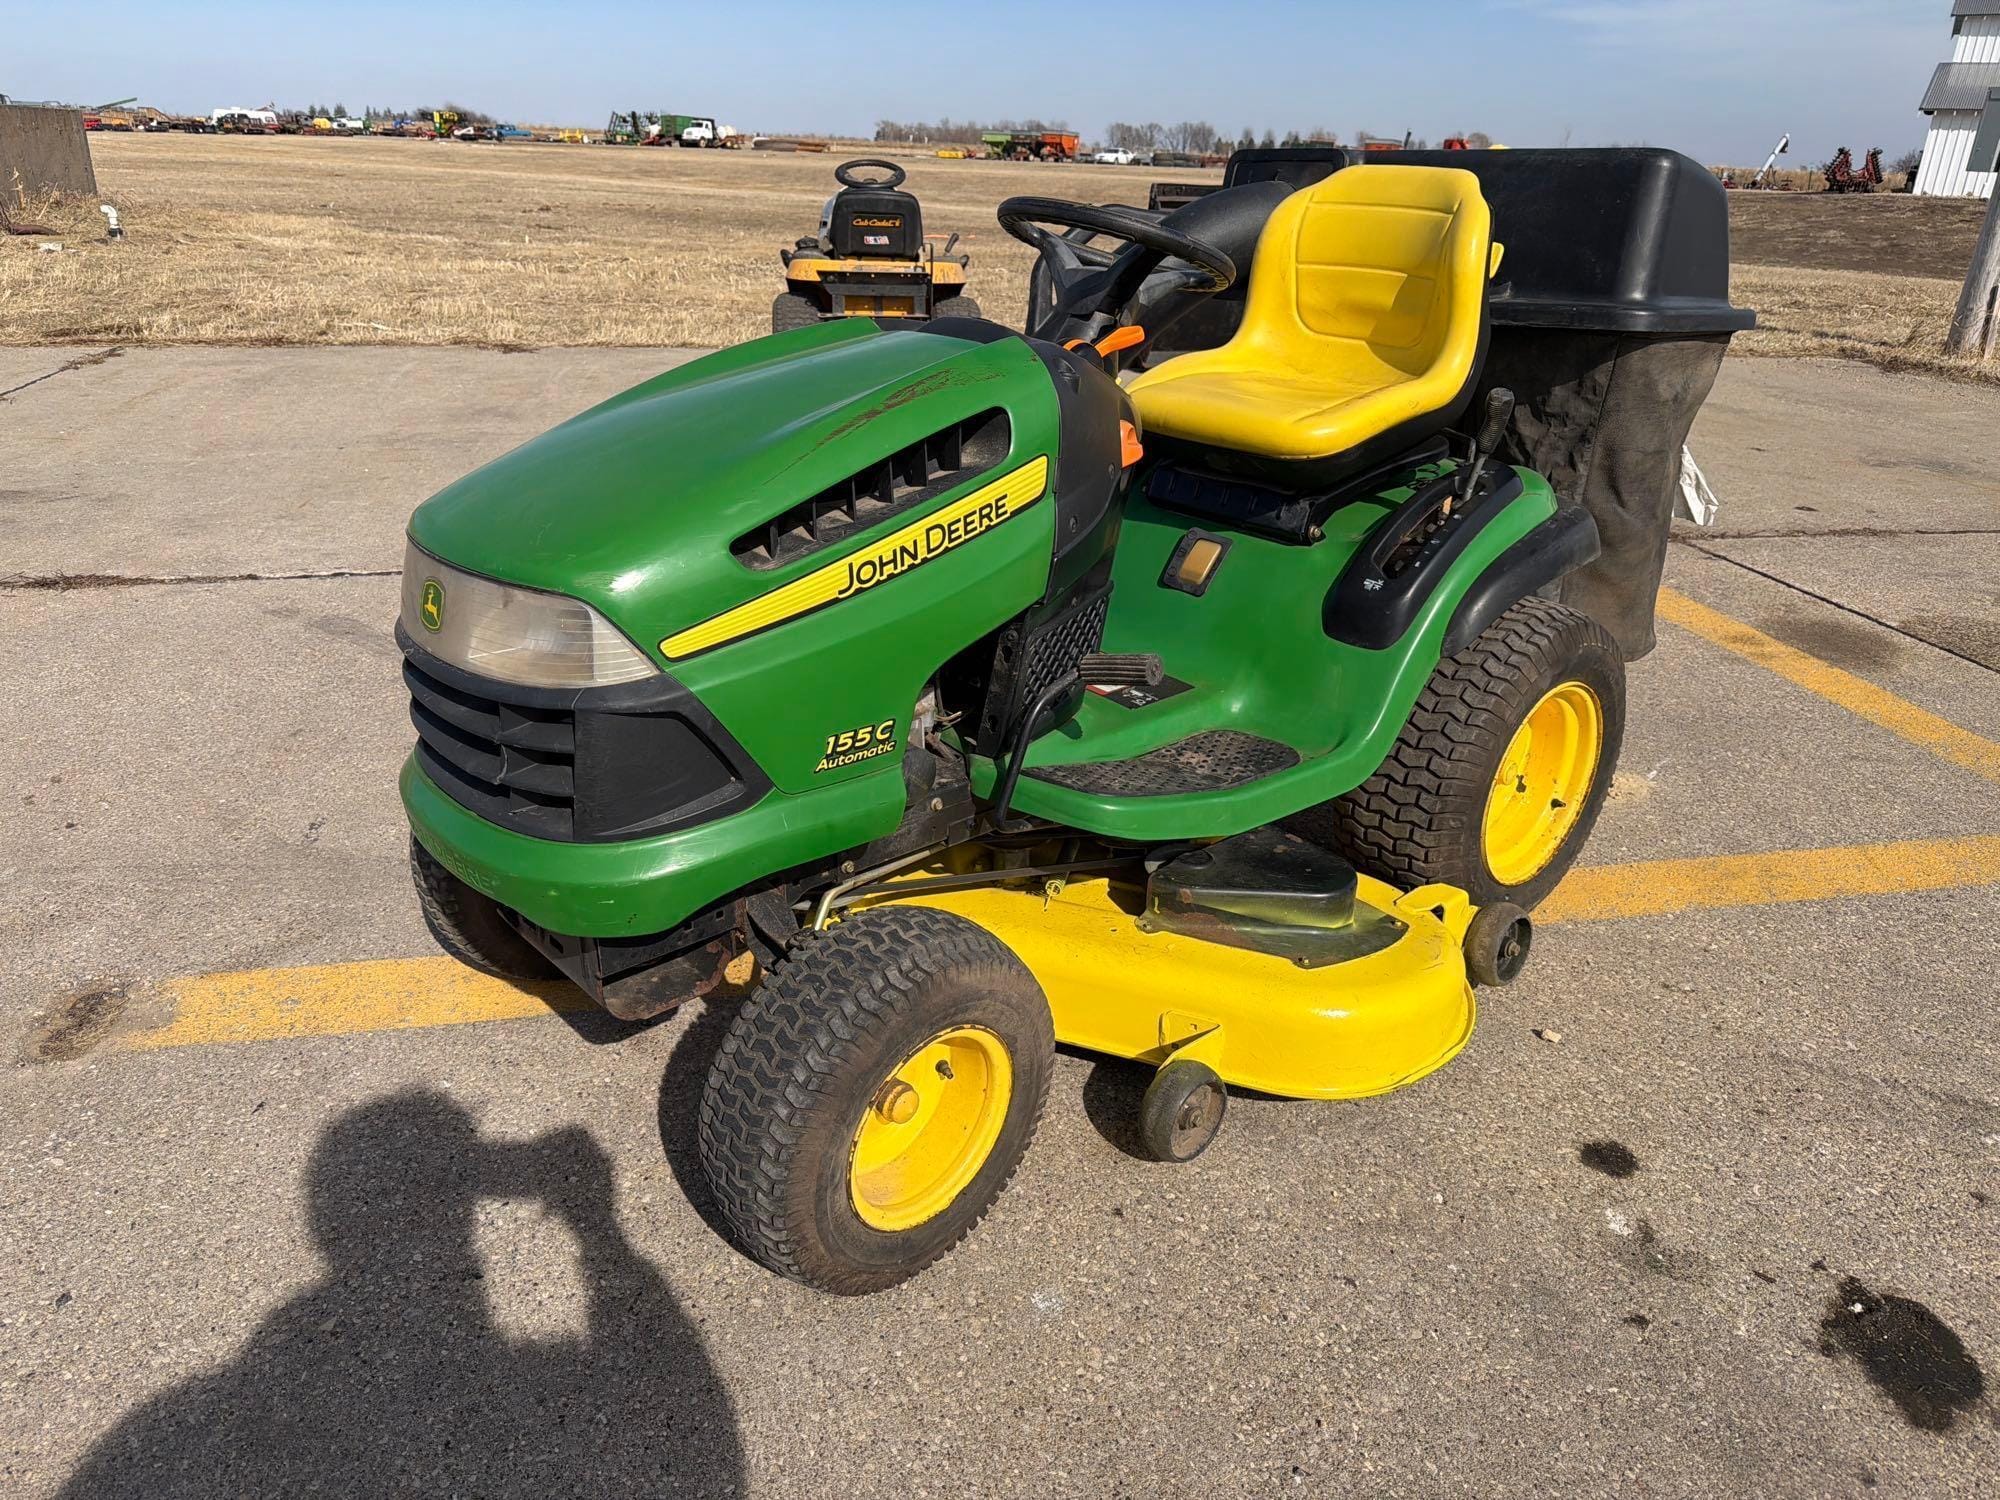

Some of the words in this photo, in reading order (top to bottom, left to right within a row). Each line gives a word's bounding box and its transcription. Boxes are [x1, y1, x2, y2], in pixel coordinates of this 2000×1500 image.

[852, 218, 869, 226] Cub
[837, 539, 918, 597] JOHN
[925, 493, 1008, 555] DEERE
[826, 726, 873, 755] 155
[876, 720, 894, 740] C
[815, 741, 896, 772] Automatic
